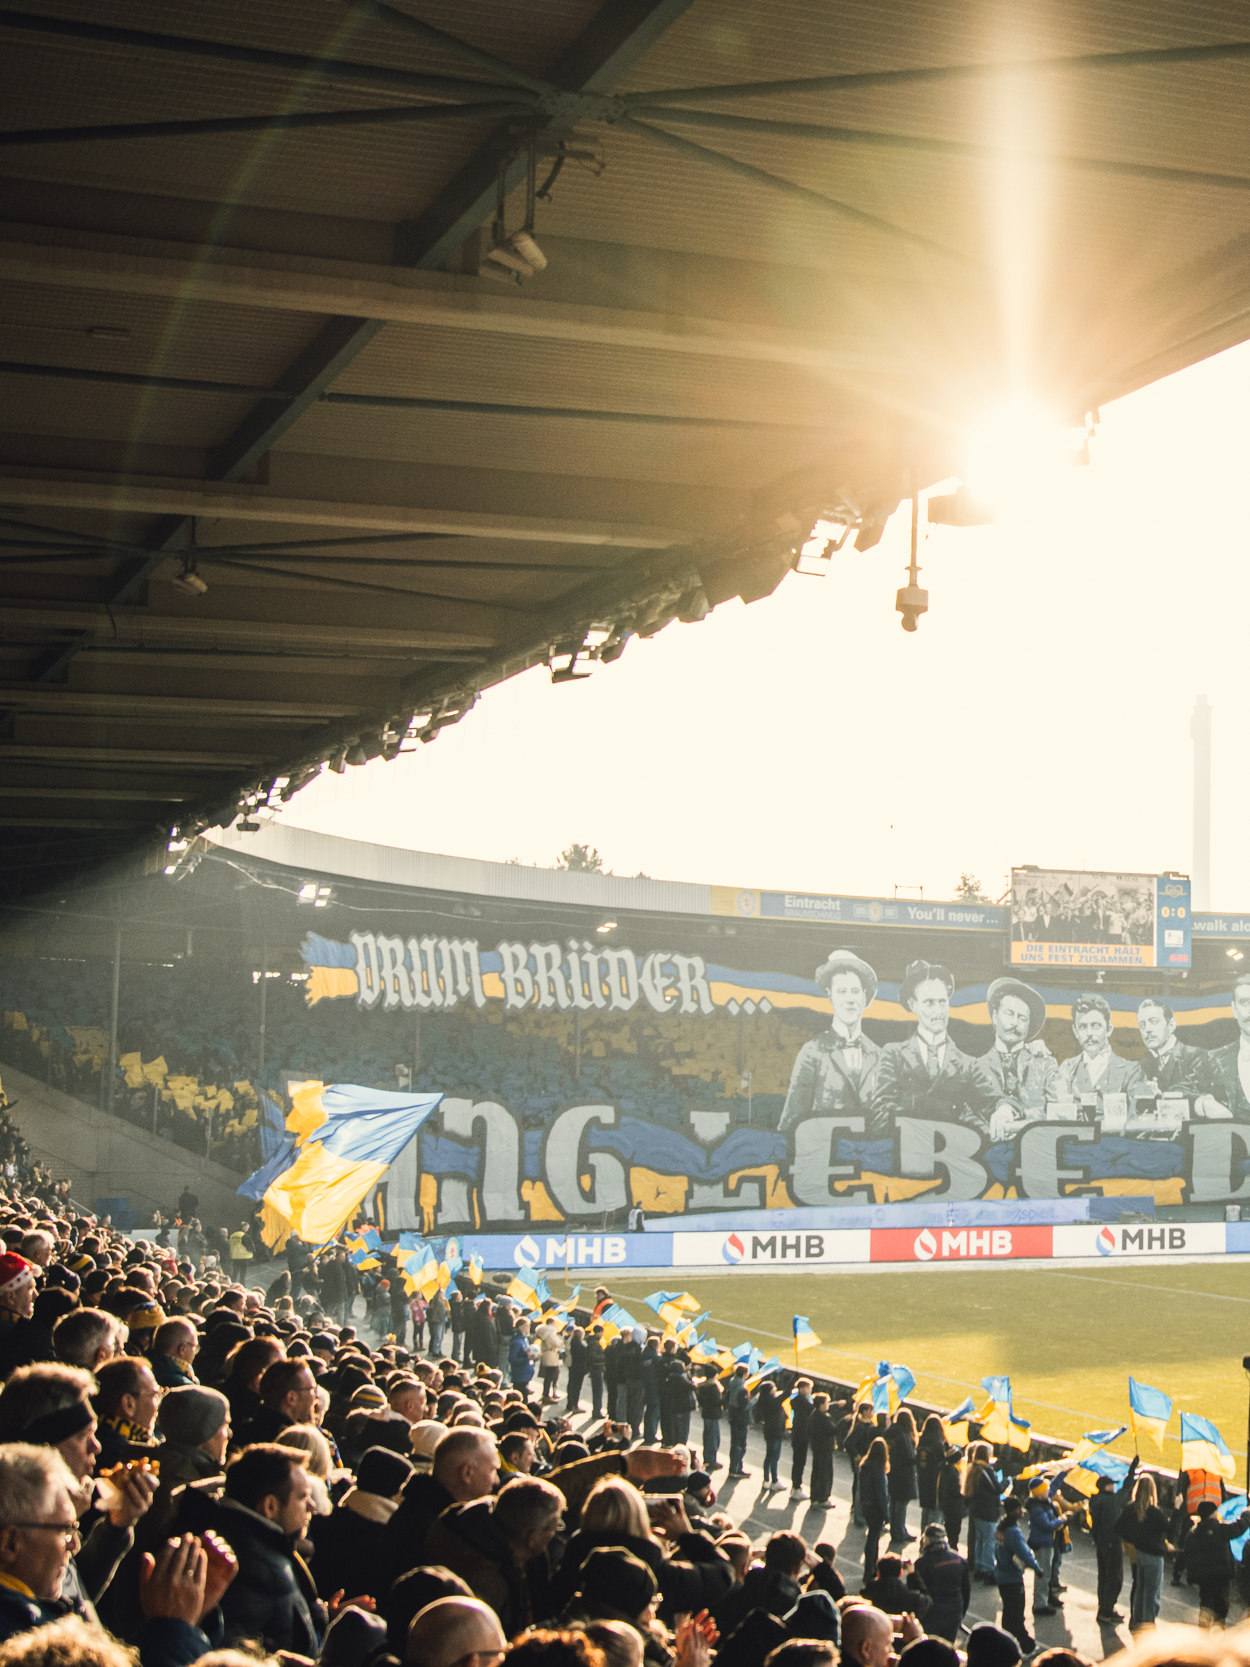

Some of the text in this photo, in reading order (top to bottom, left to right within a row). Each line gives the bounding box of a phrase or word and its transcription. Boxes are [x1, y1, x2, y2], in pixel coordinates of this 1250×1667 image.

[784, 894, 841, 911] Eintracht
[784, 909, 842, 921] BRAUNSCHWEIG
[1161, 906, 1186, 919] 0:0
[1026, 944, 1141, 955] DIE EINTRACHT HÄLT
[1021, 954, 1146, 965] UNS FEST ZUSAMMEN,
[351, 932, 486, 1008] DRUM
[752, 1235, 824, 1258] MHB
[942, 1230, 1012, 1256] MHB
[1121, 1228, 1186, 1250] MHB
[545, 1236, 626, 1264] MHB
